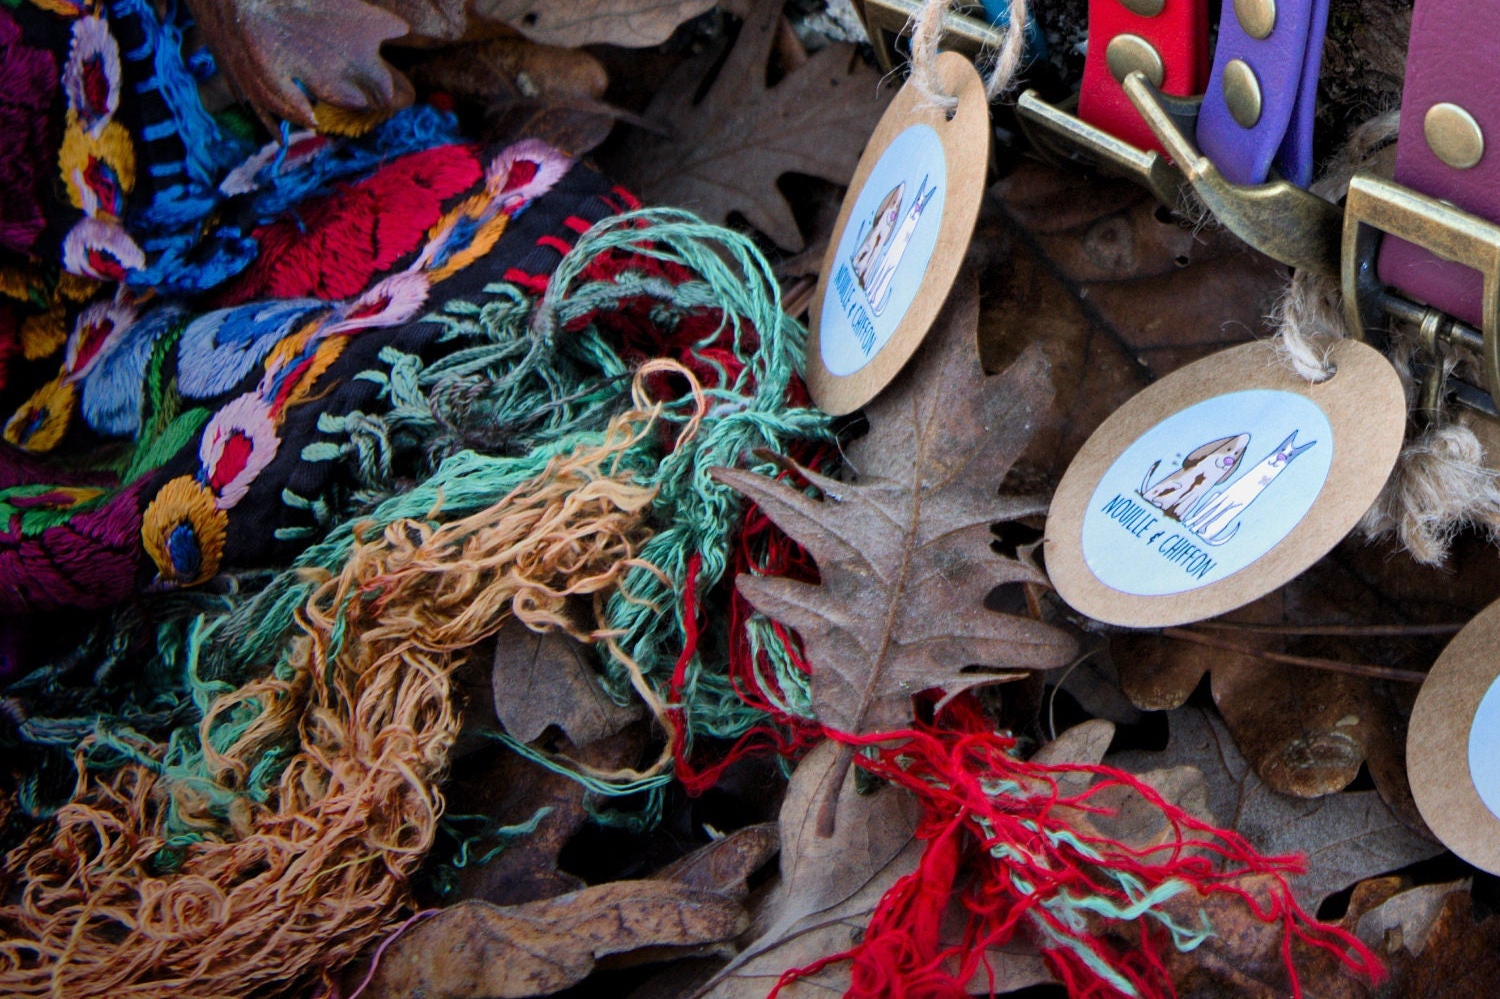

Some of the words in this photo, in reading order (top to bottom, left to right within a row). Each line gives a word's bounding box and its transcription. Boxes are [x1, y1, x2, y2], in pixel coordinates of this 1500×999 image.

[851, 303, 878, 356] CHIFFON
[1101, 493, 1159, 539] NOUILLE
[1158, 533, 1218, 580] CHIFFON
